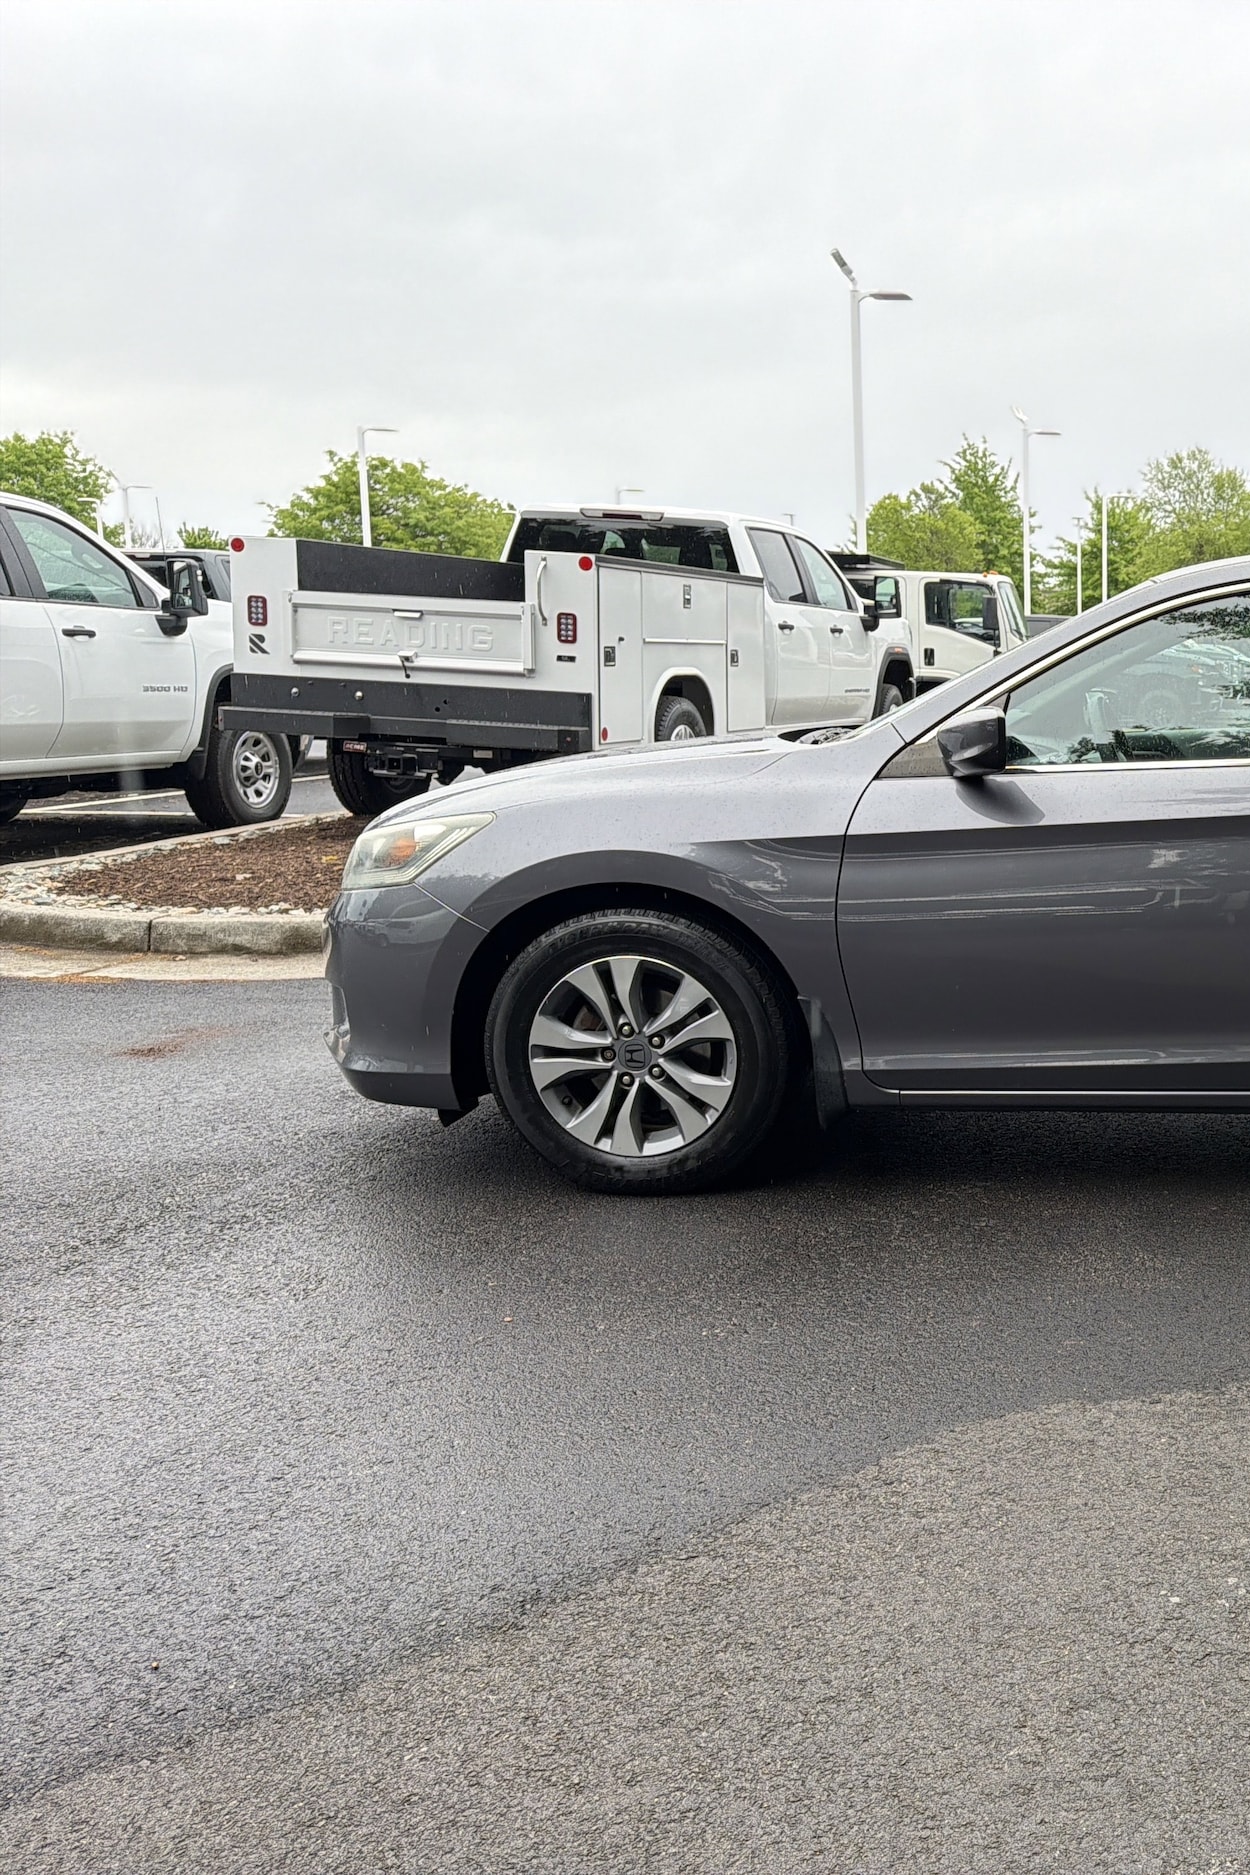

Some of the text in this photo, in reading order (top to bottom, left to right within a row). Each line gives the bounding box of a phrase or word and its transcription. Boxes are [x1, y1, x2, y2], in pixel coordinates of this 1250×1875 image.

[327, 615, 494, 651] READING
[142, 685, 188, 693] 3500 HD
